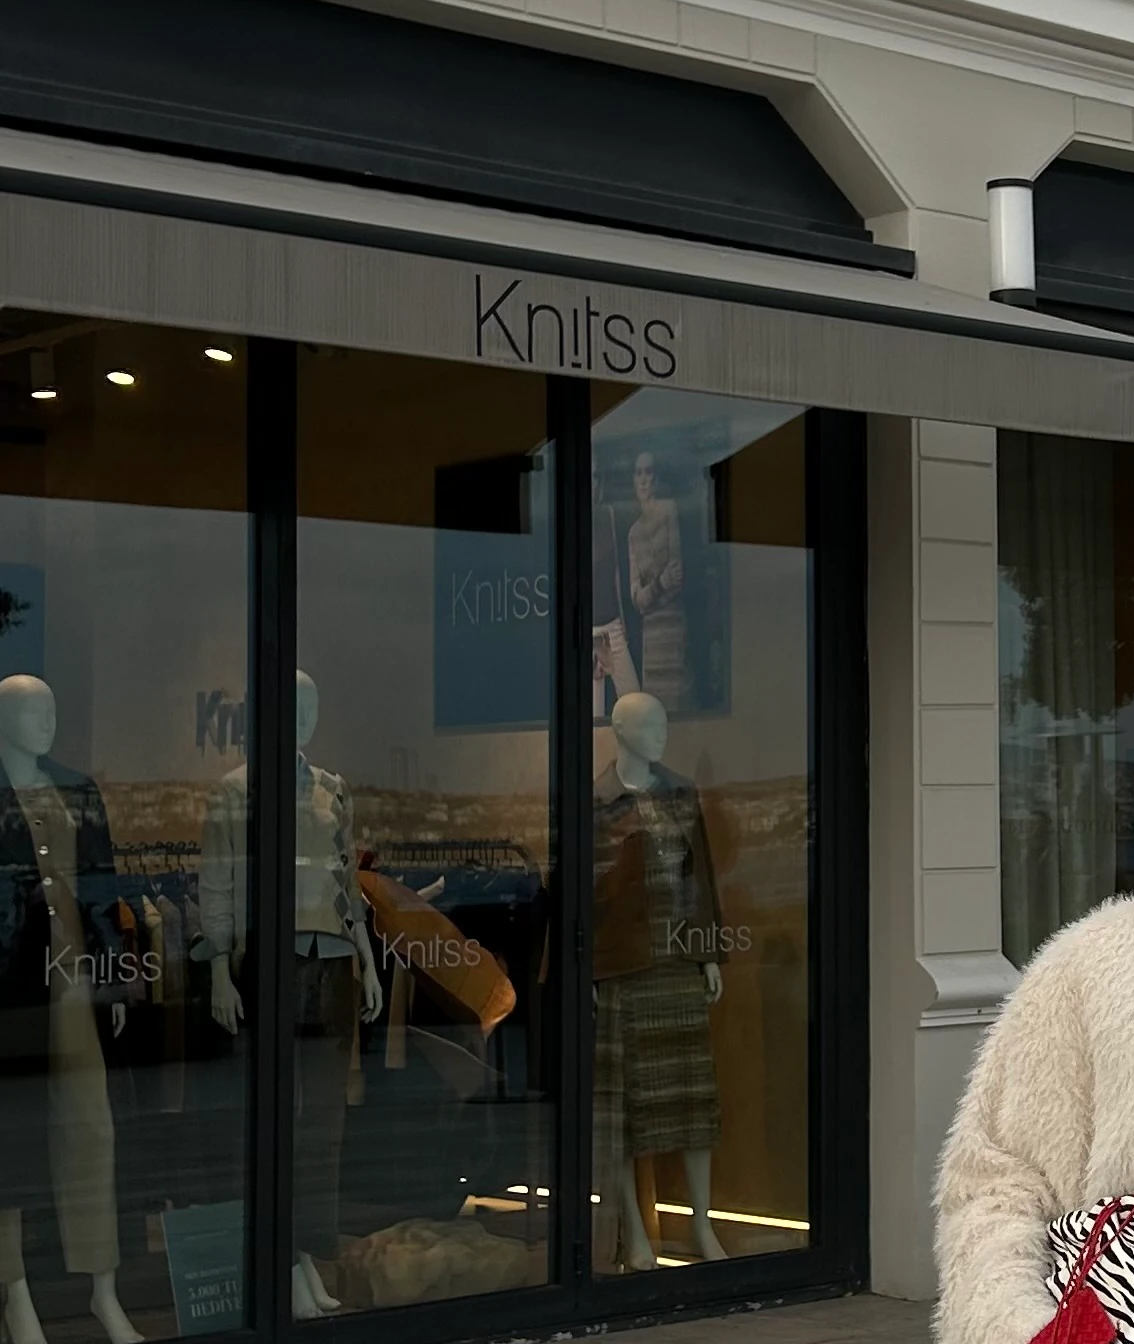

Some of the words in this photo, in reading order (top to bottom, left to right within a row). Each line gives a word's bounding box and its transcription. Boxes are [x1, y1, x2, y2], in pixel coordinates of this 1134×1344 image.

[475, 274, 676, 378] Knitss
[452, 568, 549, 626] Knitss
[383, 932, 481, 970] Knitss
[667, 919, 752, 954] Knitss
[45, 944, 161, 986] Knitss
